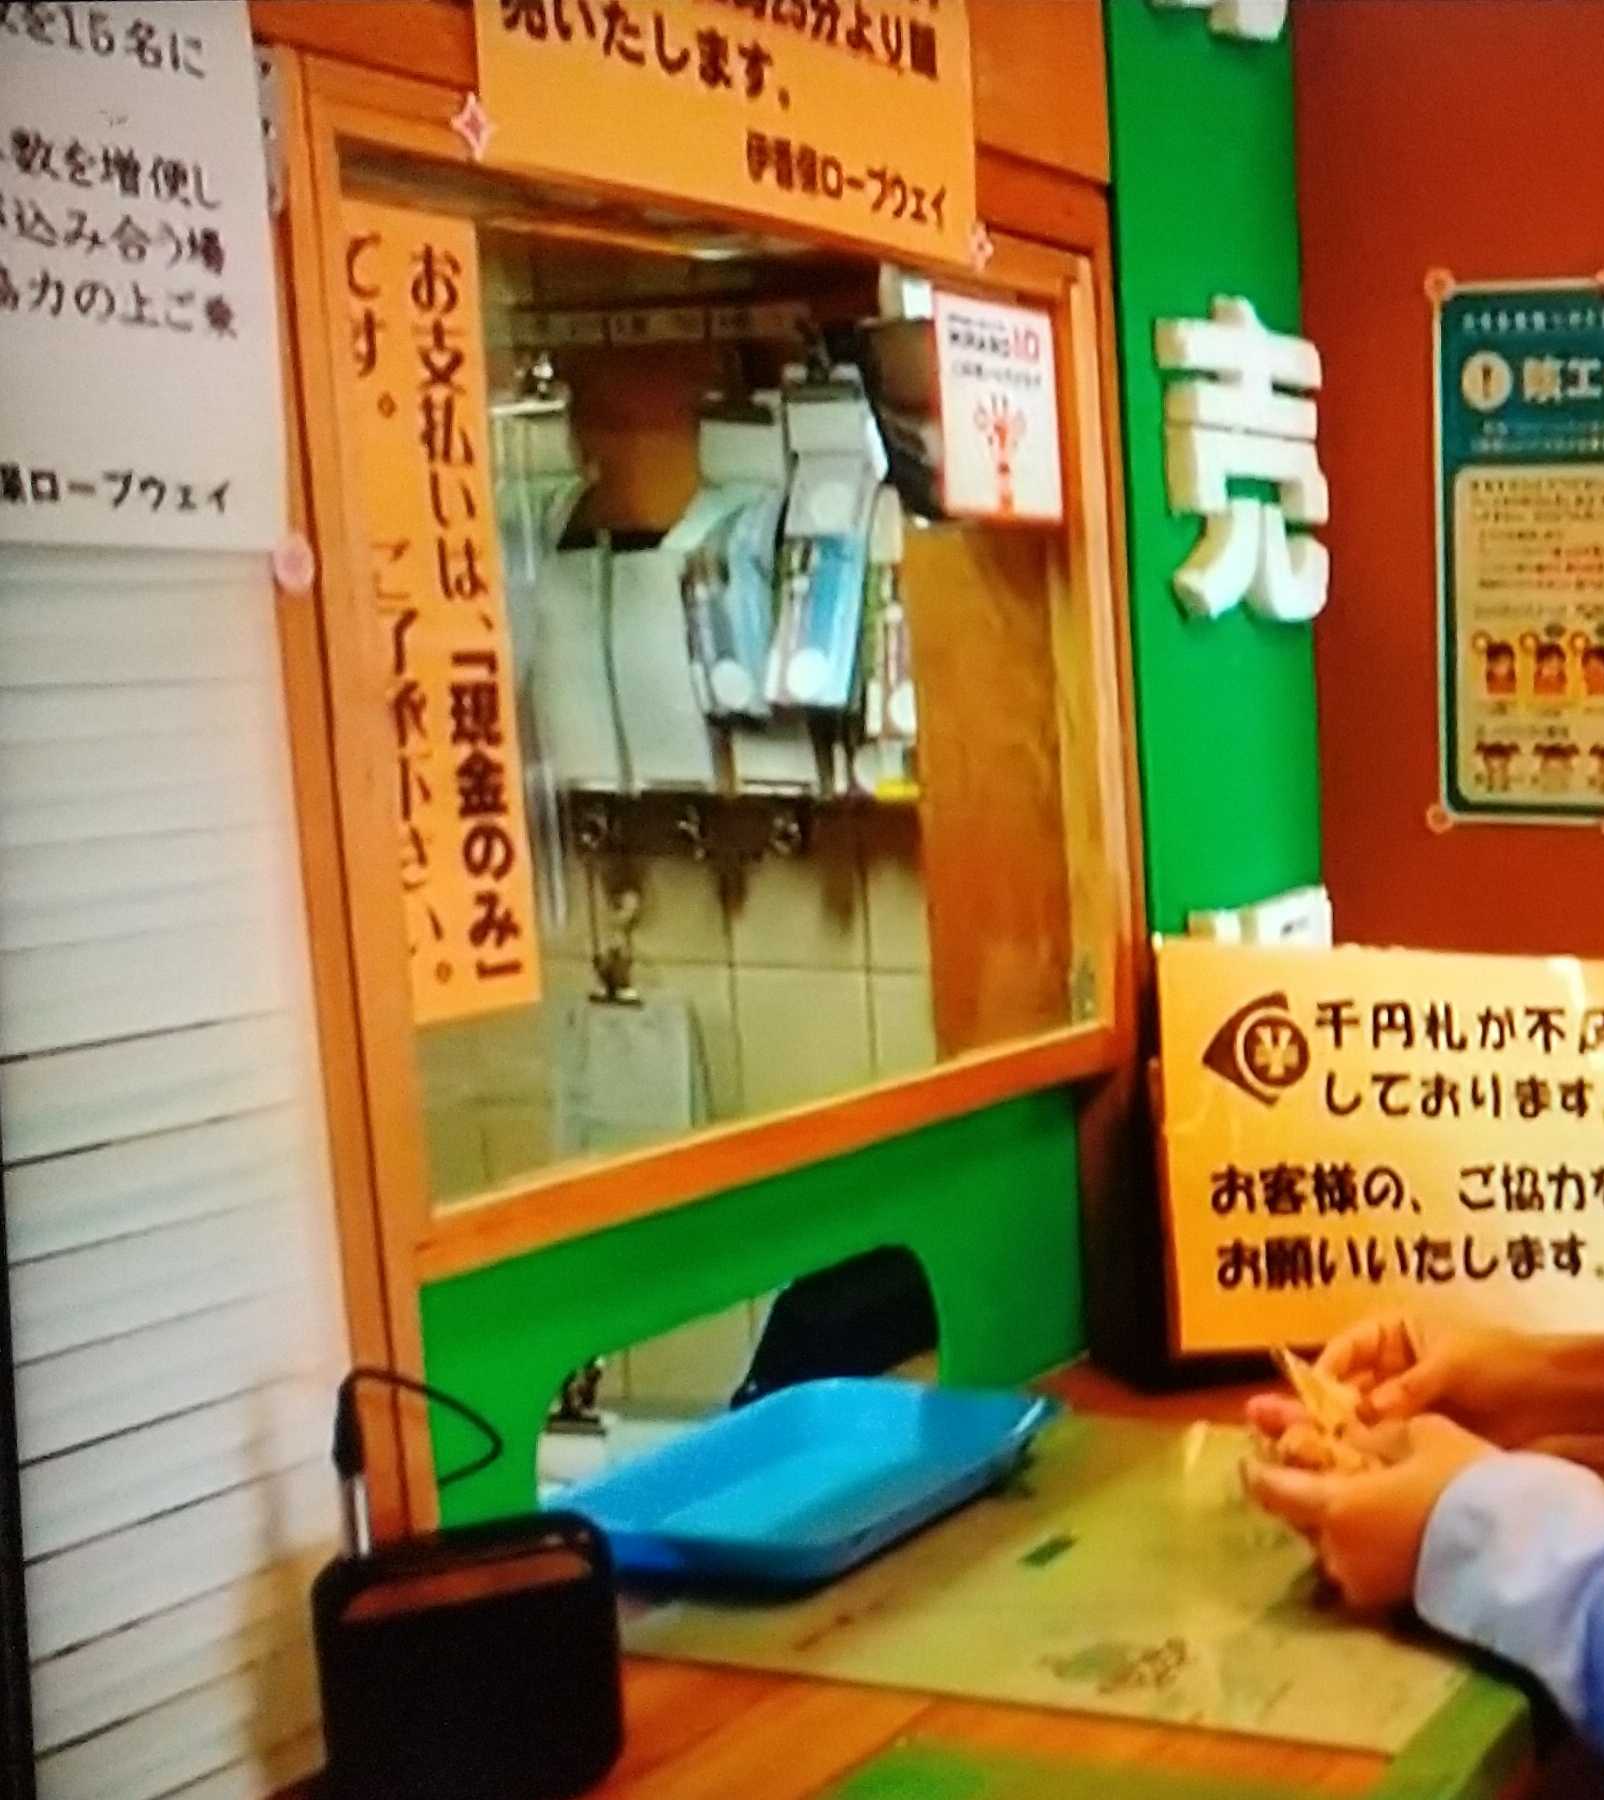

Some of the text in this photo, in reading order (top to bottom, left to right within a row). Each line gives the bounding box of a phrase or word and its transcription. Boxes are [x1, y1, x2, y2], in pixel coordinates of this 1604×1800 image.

[0, 127, 222, 210] 数を増便し
[0, 193, 226, 277] 込み合う場
[1155, 294, 1329, 621] 売
